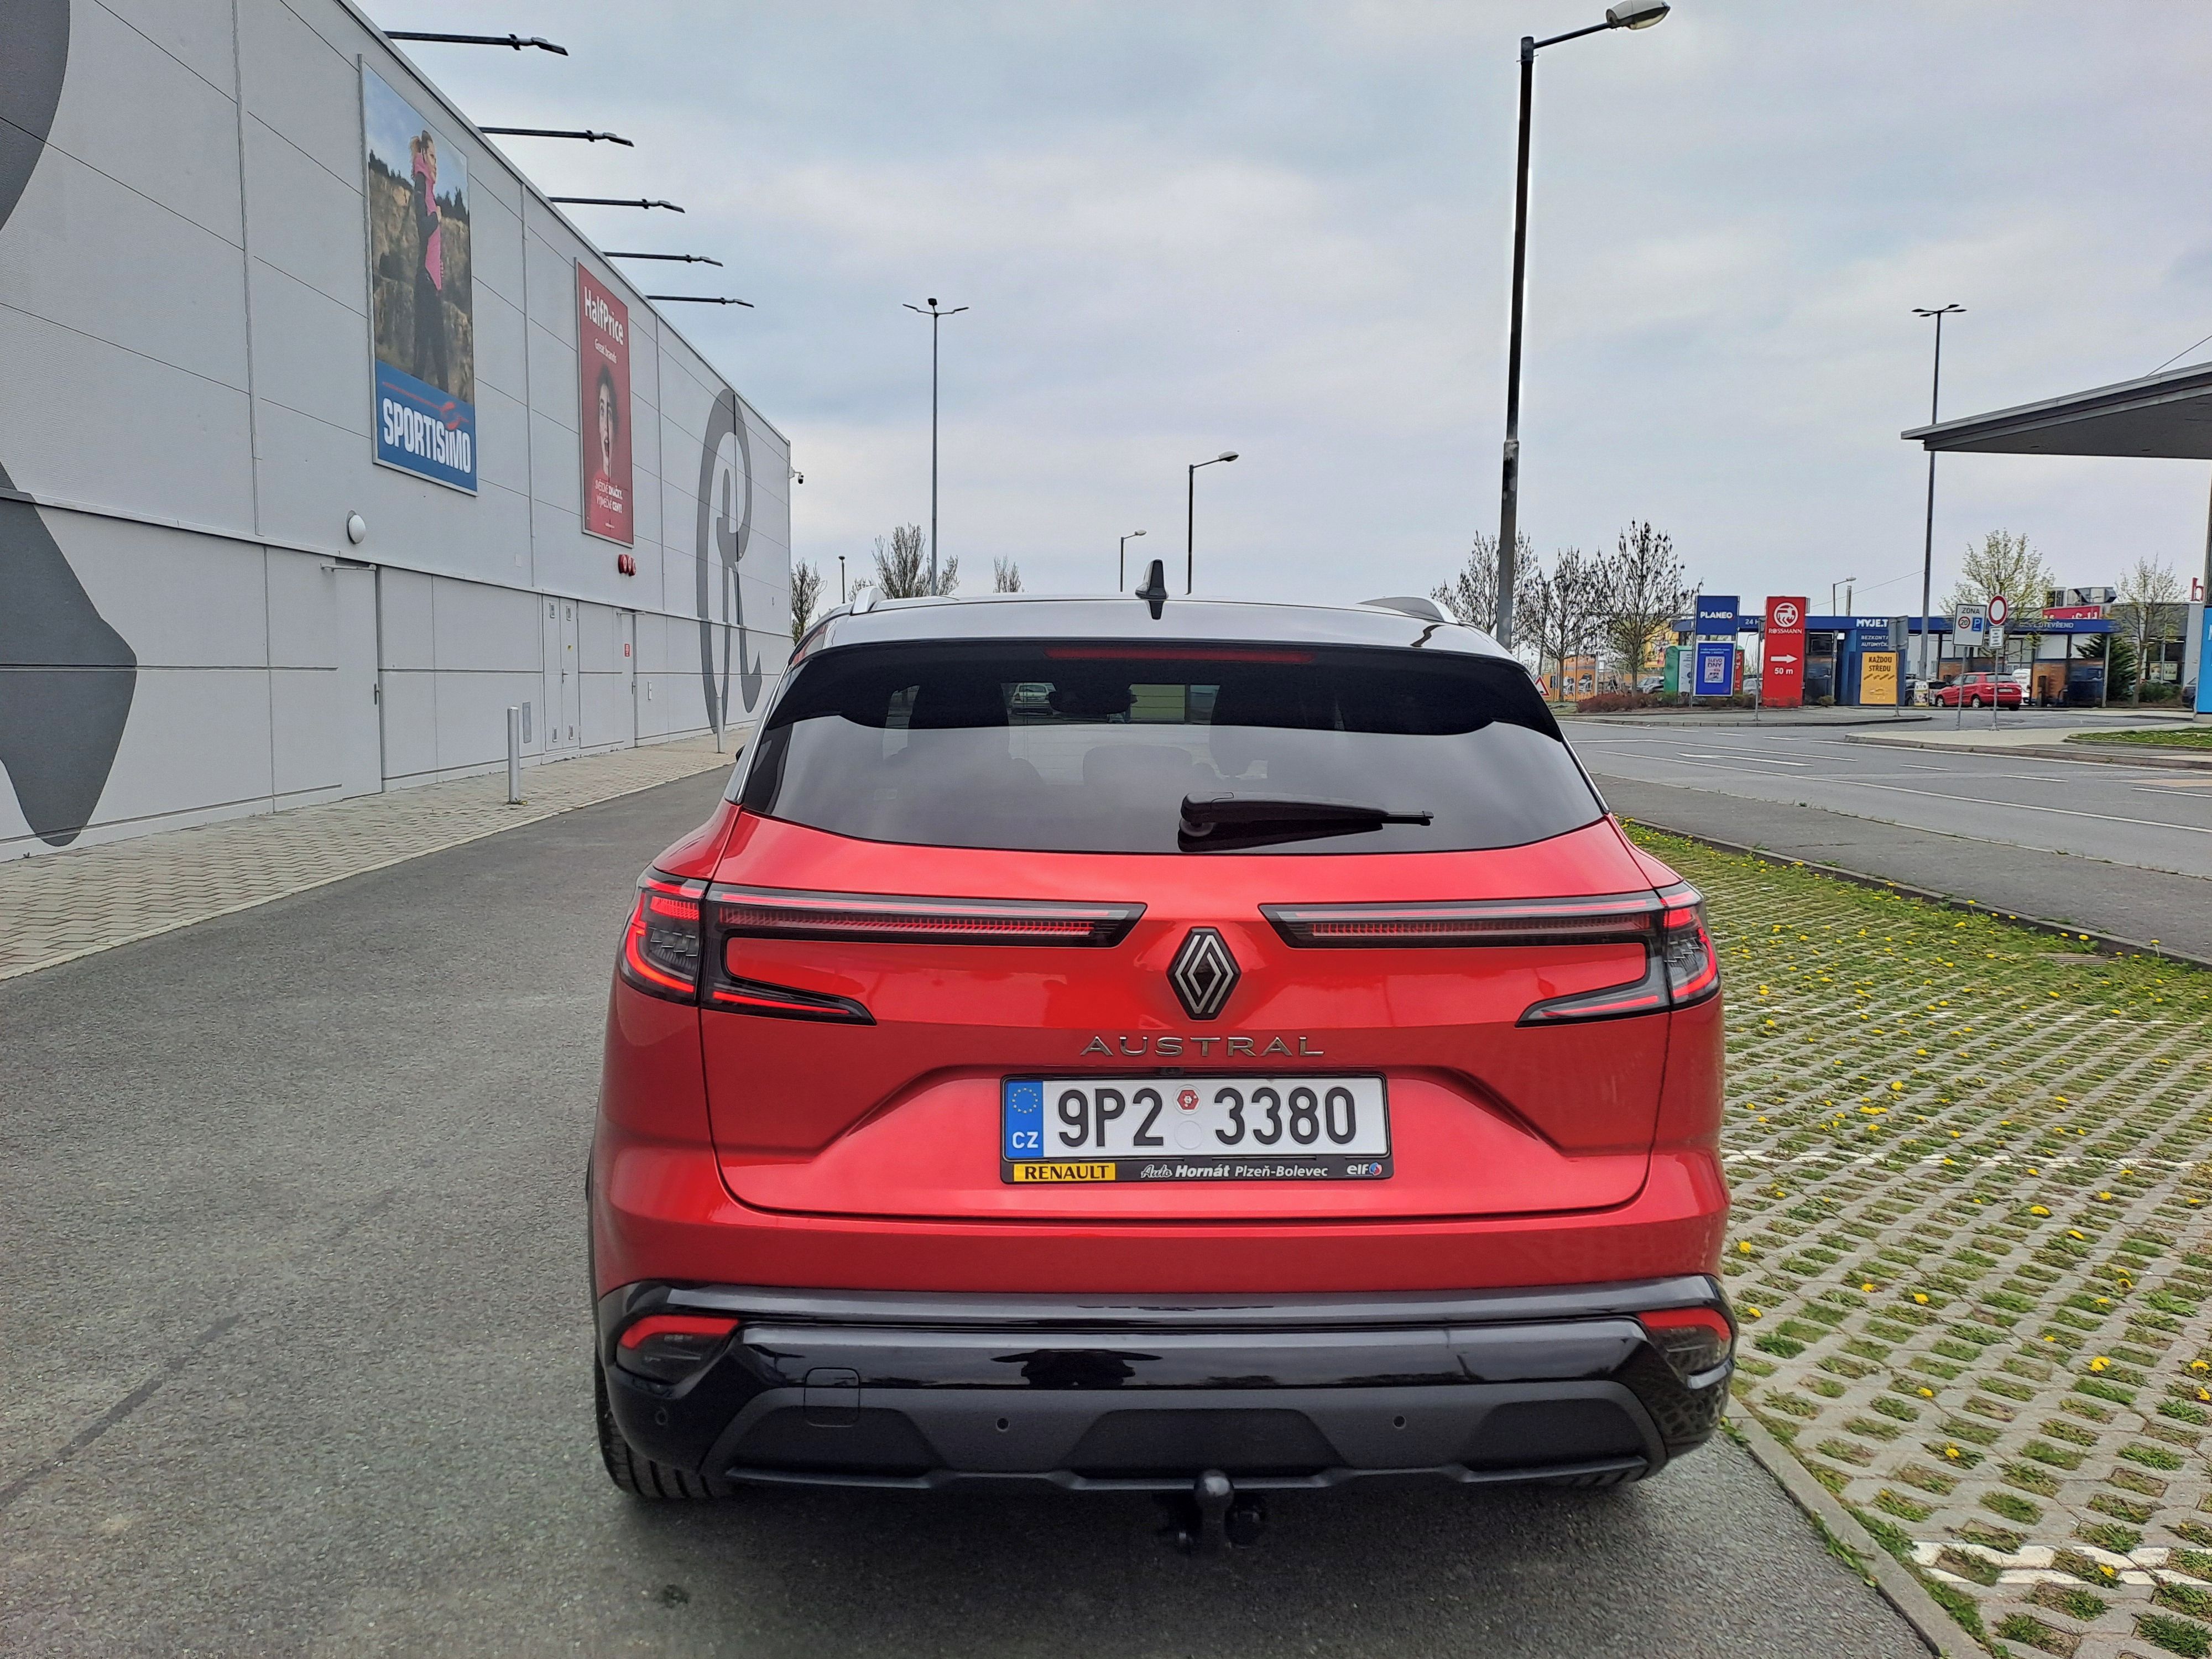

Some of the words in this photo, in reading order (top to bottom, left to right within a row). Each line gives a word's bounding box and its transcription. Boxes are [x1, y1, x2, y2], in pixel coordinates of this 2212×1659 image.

[584, 286, 624, 346] HalfPrice
[382, 397, 472, 474] SPORTISIMO
[1699, 611, 1734, 619] PLANEO
[1856, 618, 1888, 628] MYJE.T
[1868, 655, 1892, 663] KAŽDOU
[1079, 1036, 1324, 1056] AUSTRAL
[1058, 1088, 1164, 1147] 9P2
[1214, 1086, 1356, 1145] 3380
[1011, 1131, 1039, 1149] CZ
[1024, 1165, 1110, 1180] RENAULT
[1140, 1164, 1173, 1179] Auto
[1175, 1162, 1231, 1178] Hornát
[1234, 1164, 1328, 1177] Plzeň-Bolevec
[1346, 1164, 1369, 1175] elf
